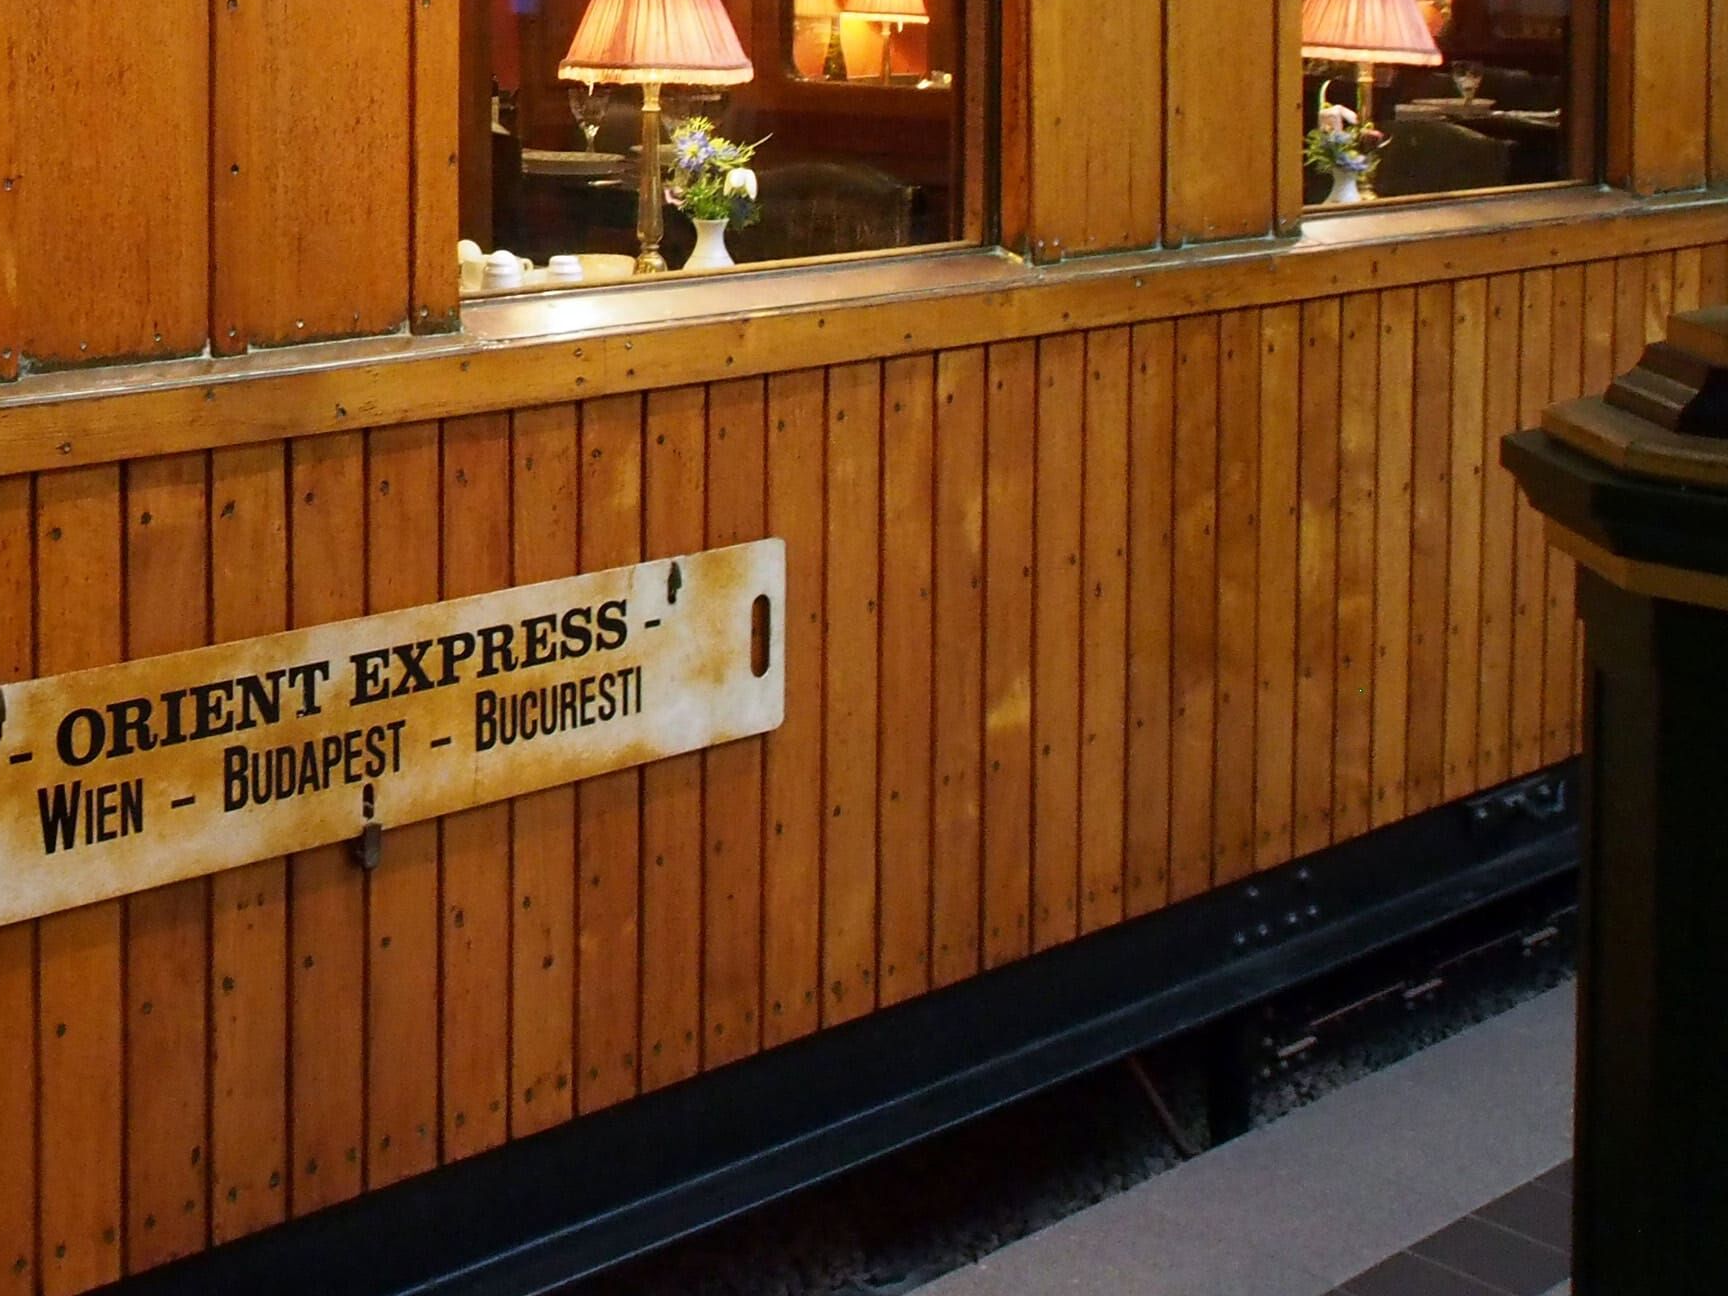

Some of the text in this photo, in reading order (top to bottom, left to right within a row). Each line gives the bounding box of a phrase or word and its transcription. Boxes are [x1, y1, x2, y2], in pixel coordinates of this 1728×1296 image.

[37, 778, 144, 855] WIEN
[223, 719, 407, 813] BUDAPEST
[475, 665, 643, 752] BUCURESTI
[56, 660, 330, 767] ORIENT
[349, 599, 628, 707] EXPRESS
